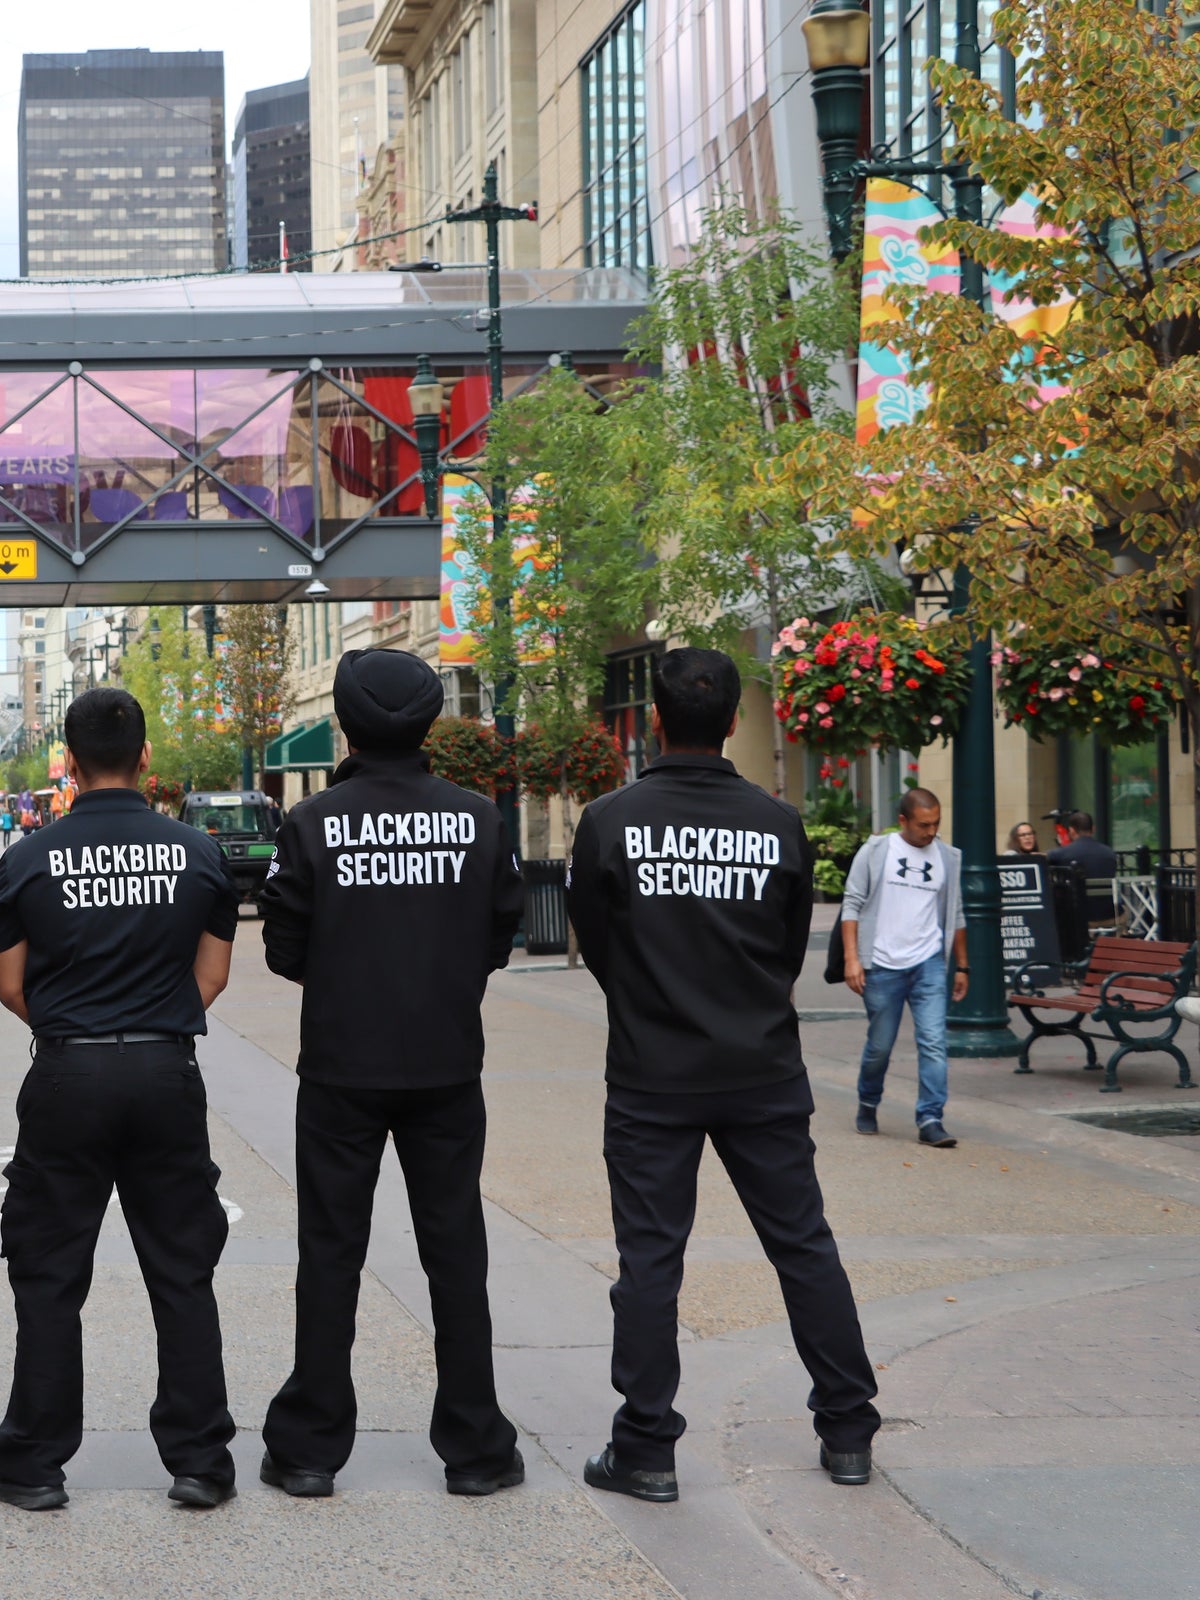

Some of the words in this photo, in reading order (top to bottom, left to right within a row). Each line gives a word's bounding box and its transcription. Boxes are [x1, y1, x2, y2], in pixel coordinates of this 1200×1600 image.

[16, 547, 30, 558] m
[323, 812, 476, 848] BLACKBIRD
[624, 825, 780, 865] BLACKBIRD
[49, 843, 187, 877] BLACKBIRD
[337, 851, 466, 887] SECURITY
[62, 875, 178, 910] SECURITY
[637, 862, 770, 901] SECURITY
[999, 871, 1026, 887] SSO
[1000, 926, 1031, 938] STRIES
[1003, 937, 1035, 948] AKFAST
[1003, 949, 1028, 960] UNCH
